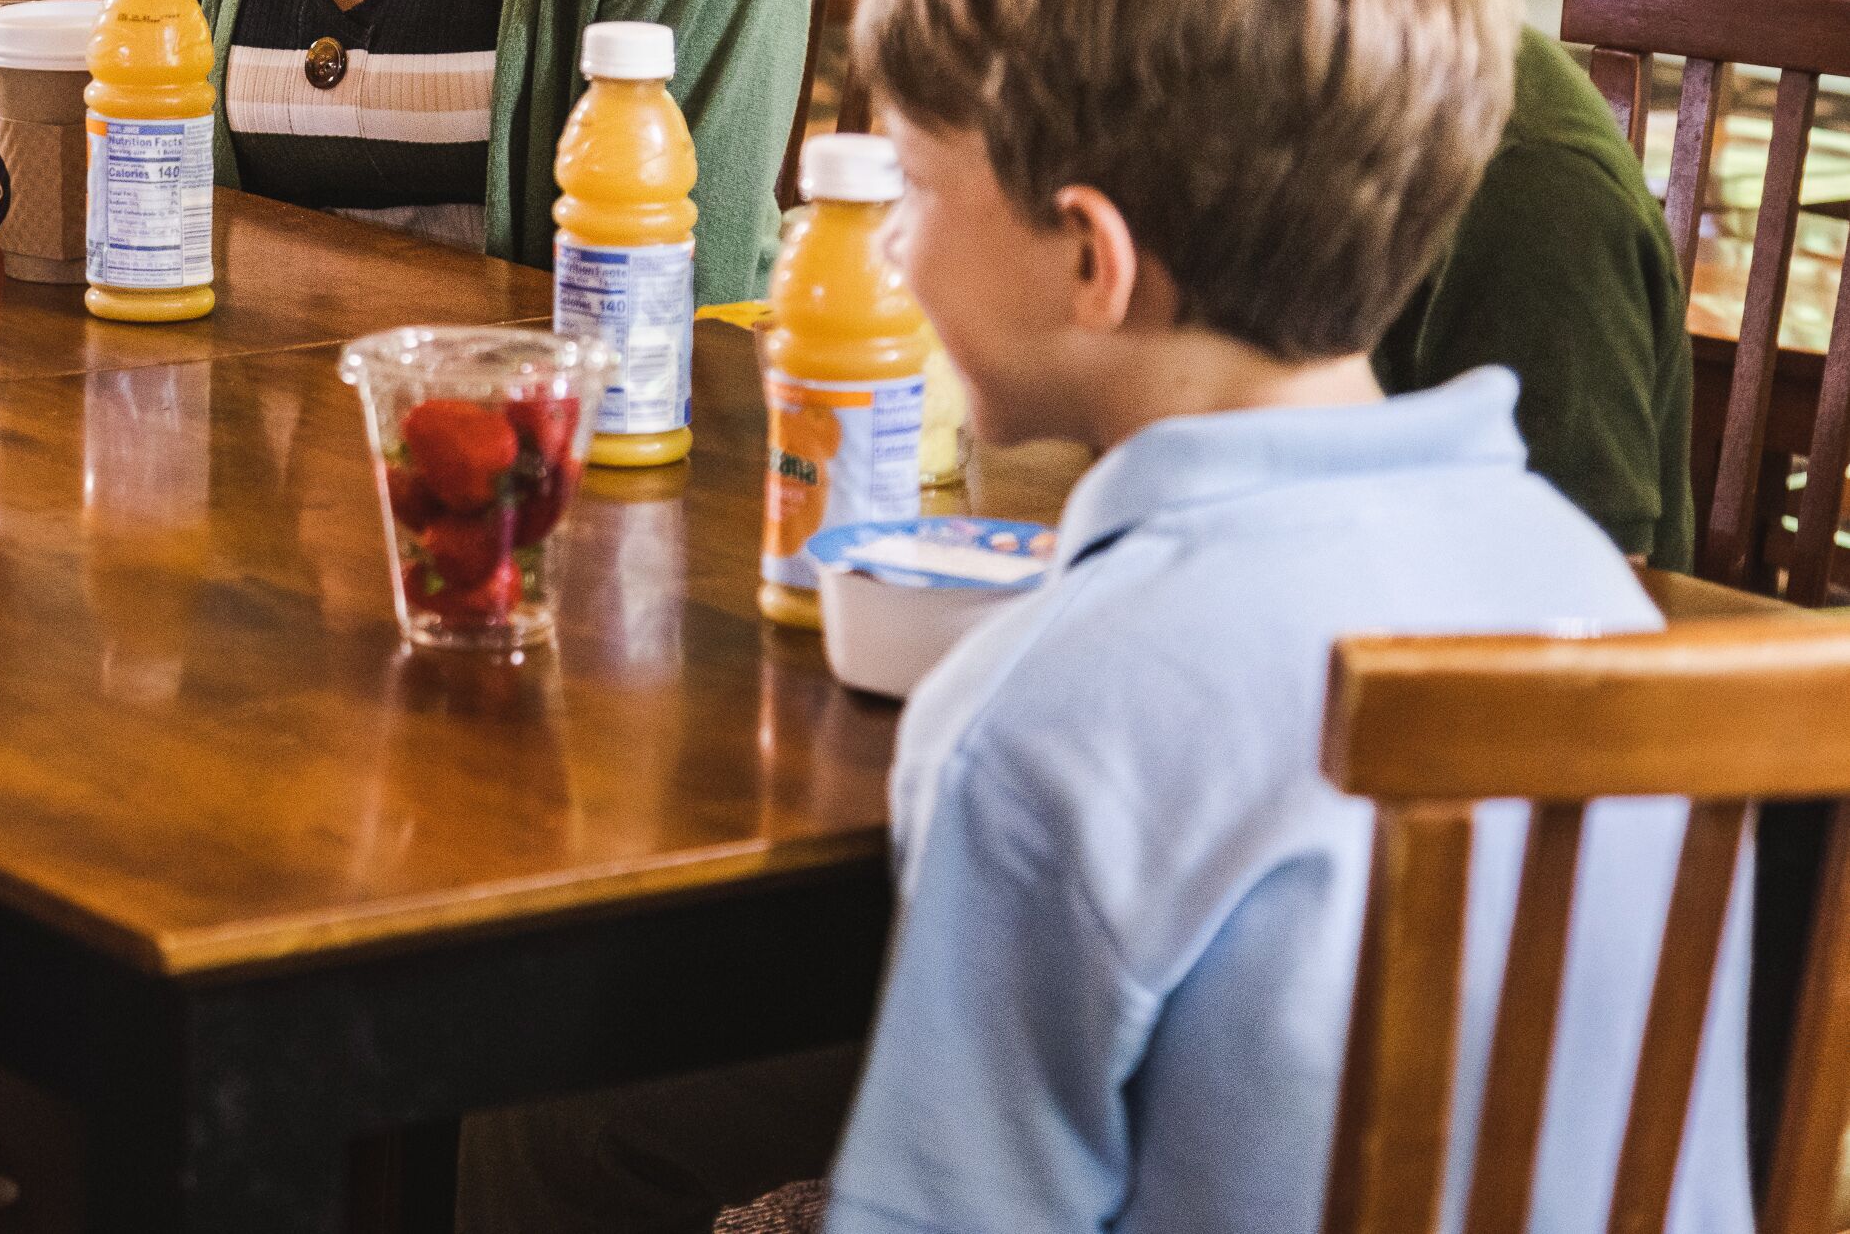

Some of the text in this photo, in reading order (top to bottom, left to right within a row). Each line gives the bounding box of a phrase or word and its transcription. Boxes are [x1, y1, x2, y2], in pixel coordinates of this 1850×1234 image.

[108, 136, 183, 147] Nutrition Facts
[109, 166, 180, 179] Calories 140
[600, 300, 626, 313] 140
